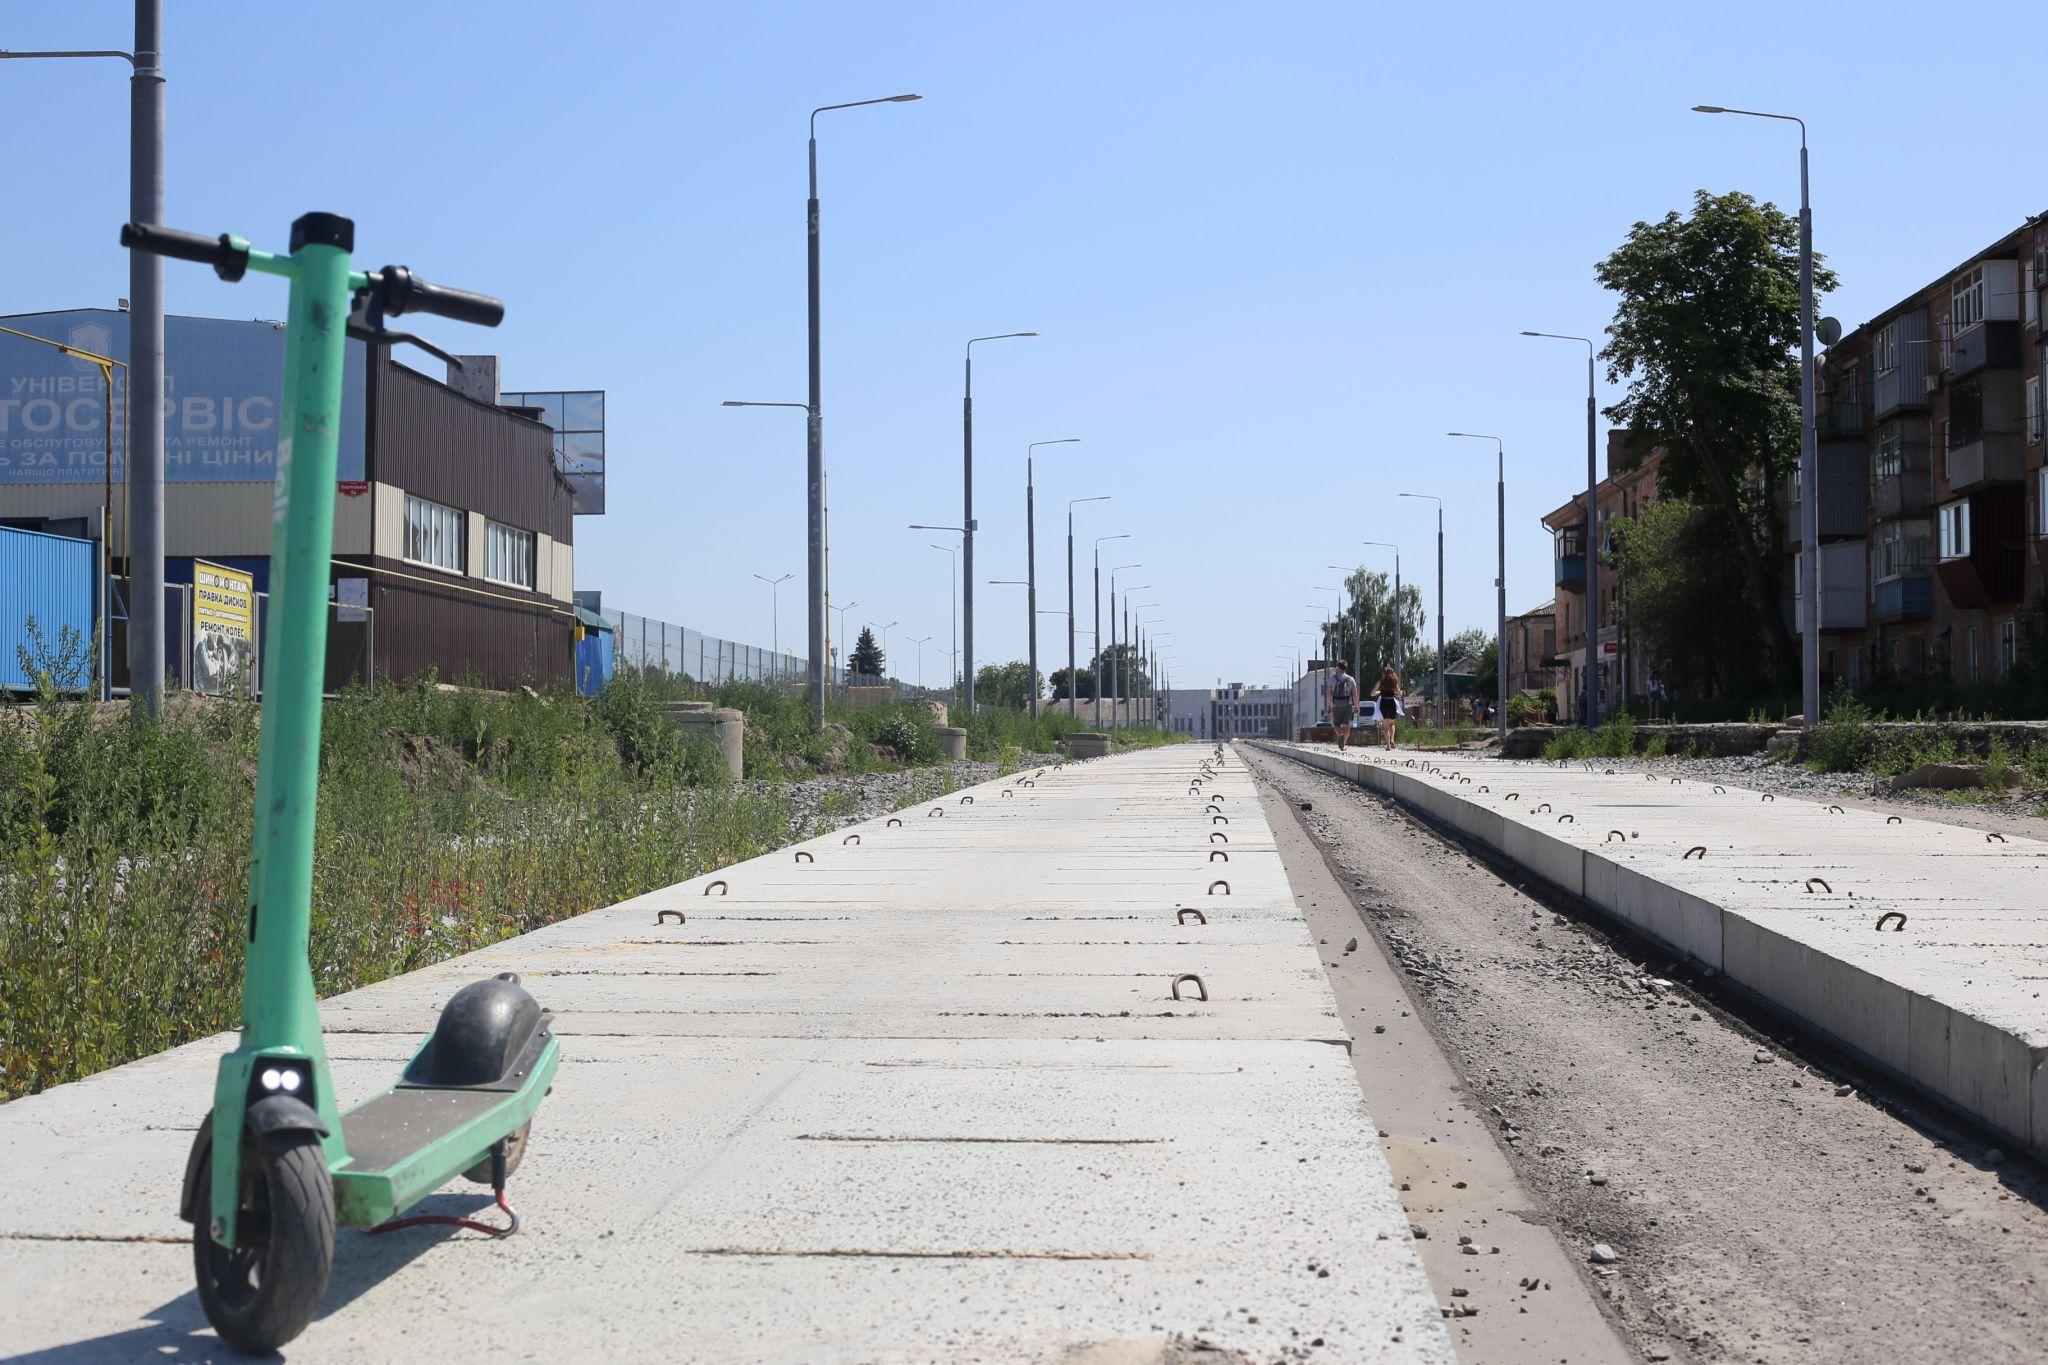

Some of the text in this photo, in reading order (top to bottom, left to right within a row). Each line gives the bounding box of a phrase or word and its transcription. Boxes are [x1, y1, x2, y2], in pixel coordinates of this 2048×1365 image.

[187, 437, 253, 446] РЕМОНТ
[21, 452, 58, 466] ЗА
[203, 450, 273, 466] ЦІНИ
[8, 469, 55, 478] НАВІЩО
[199, 572, 247, 594] ШИНОМОНТАЖ
[199, 589, 248, 609] ПРАВКА ДИСКОВ
[200, 620, 244, 638] РЕМОНТ КОЛЁС
